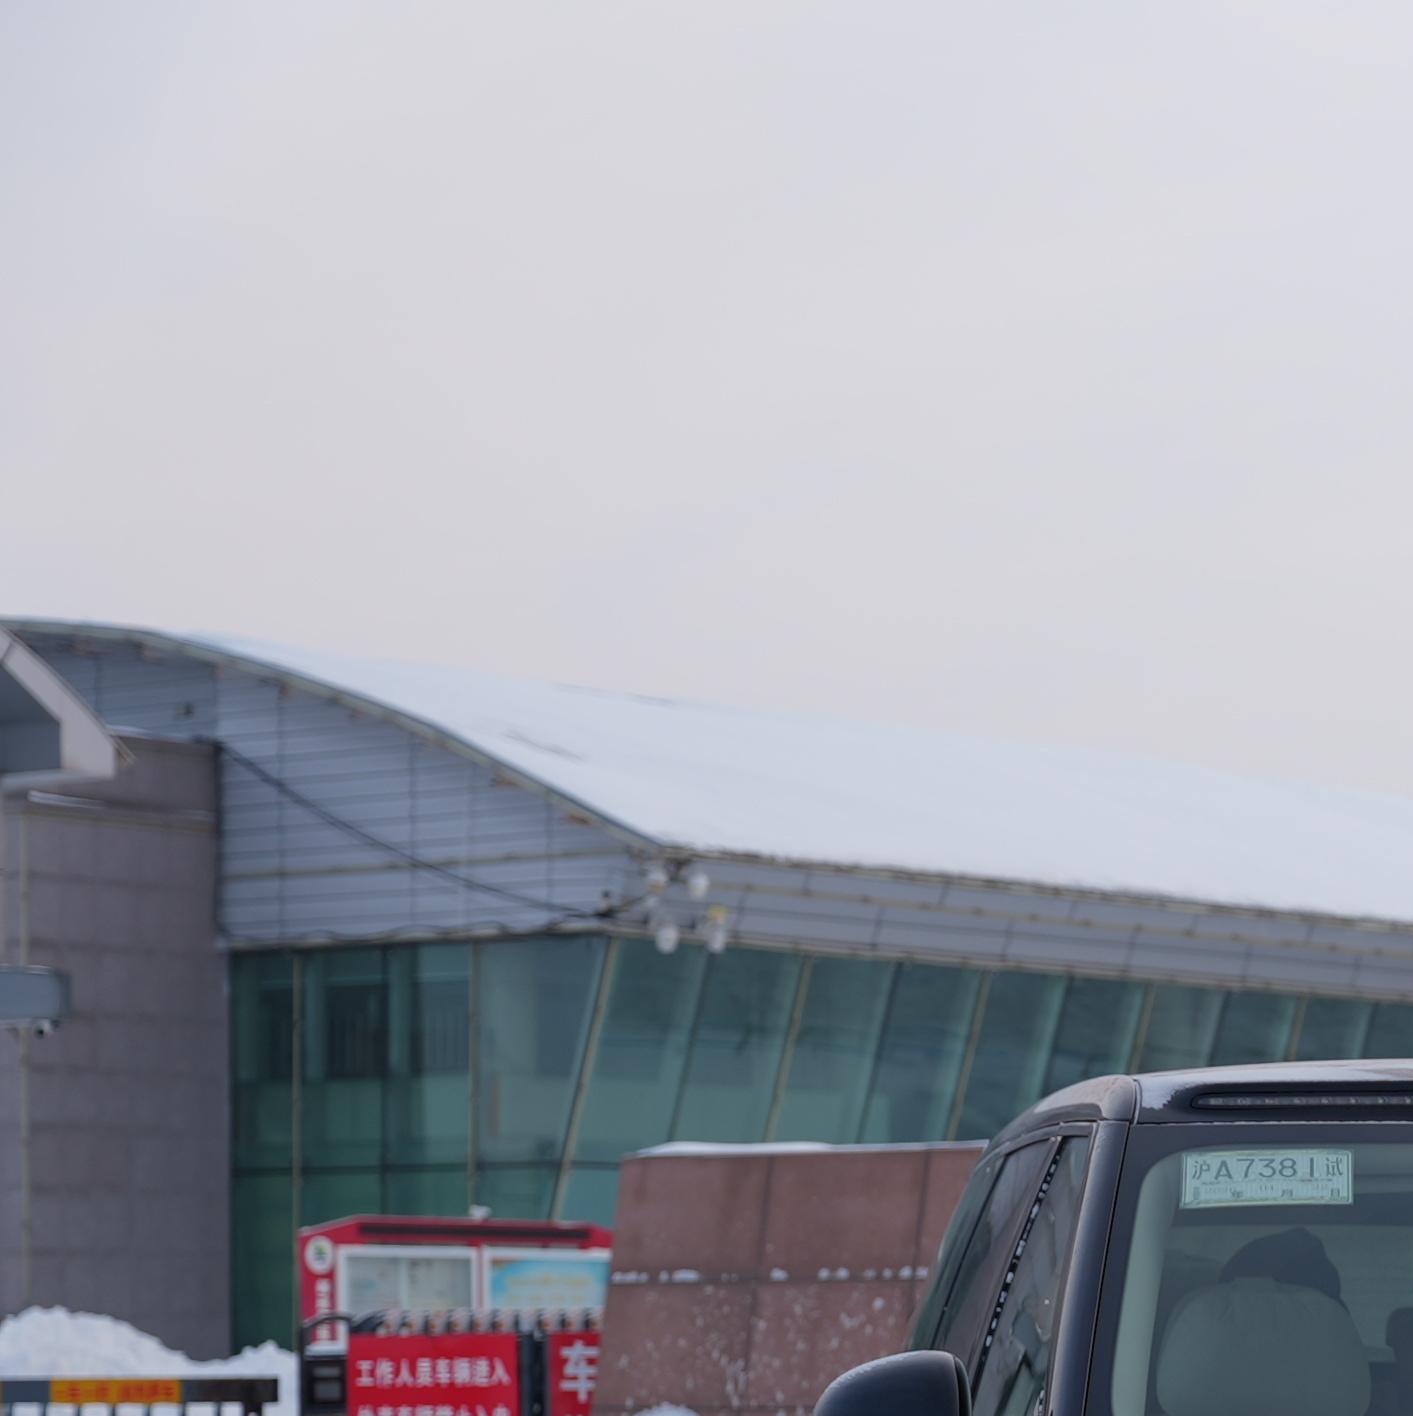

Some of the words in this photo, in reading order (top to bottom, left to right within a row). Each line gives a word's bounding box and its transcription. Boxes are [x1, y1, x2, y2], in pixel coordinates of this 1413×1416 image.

[355, 1356, 512, 1388] 工作人员车辆进入
